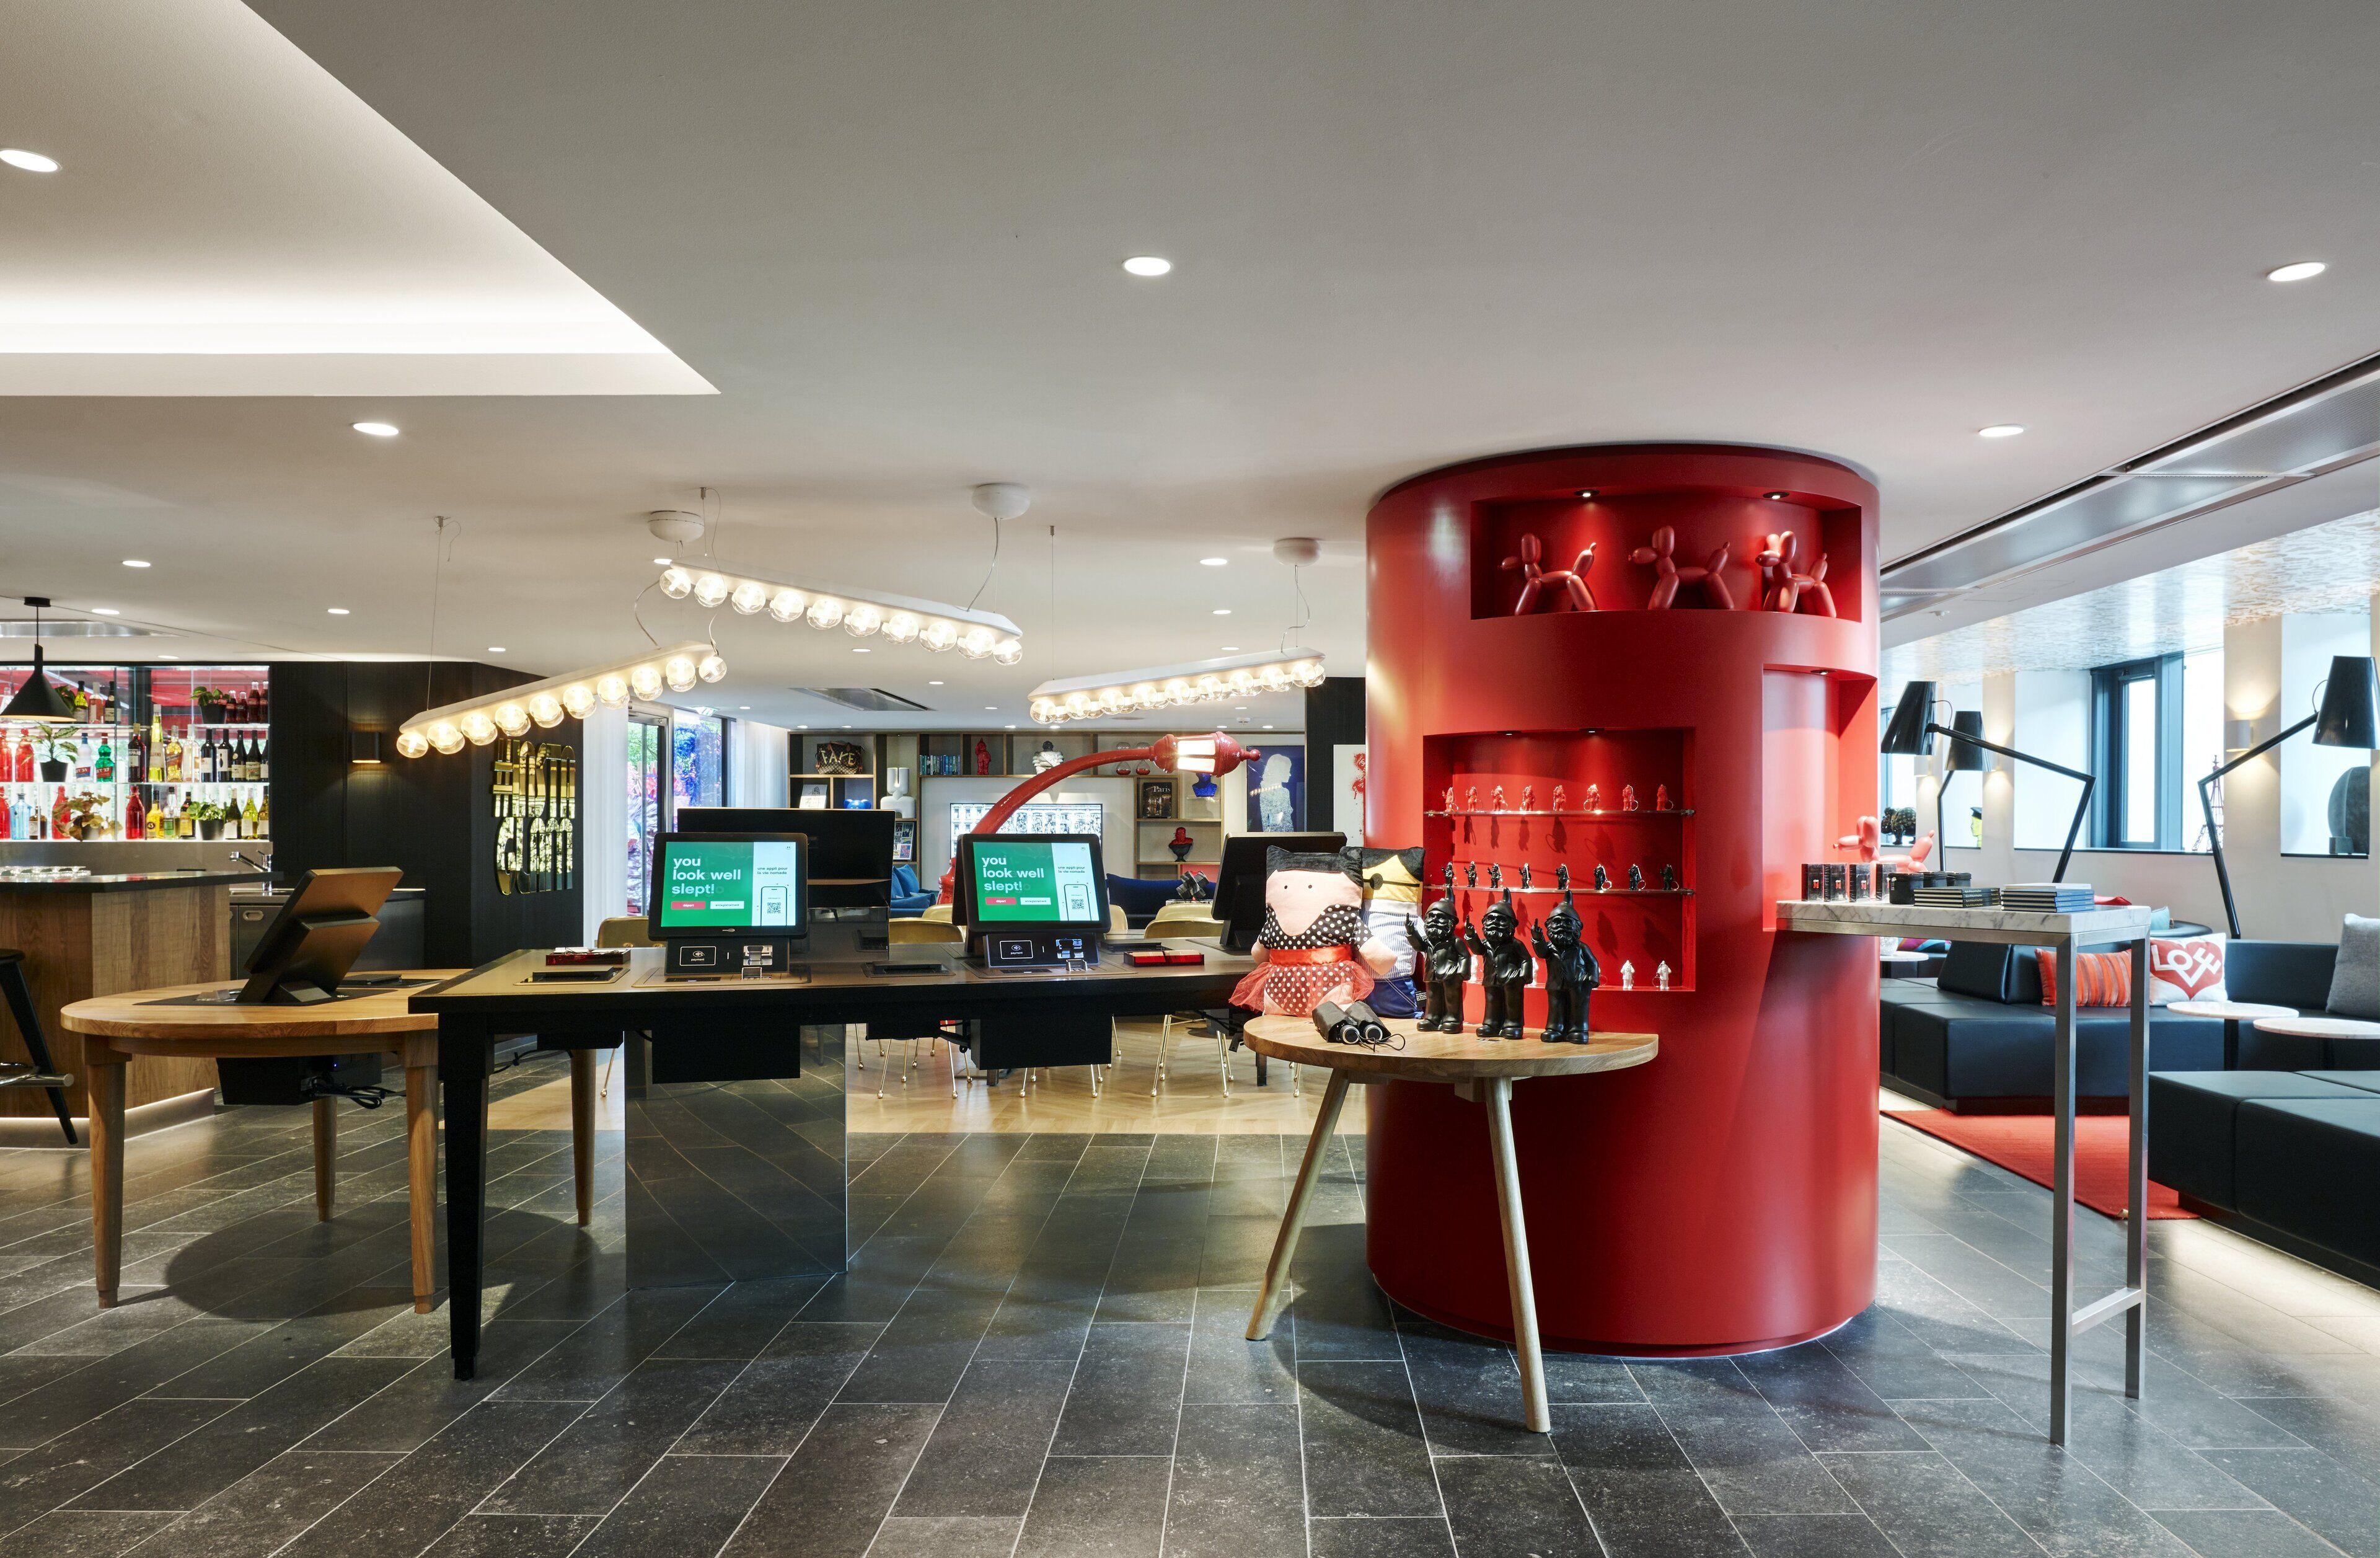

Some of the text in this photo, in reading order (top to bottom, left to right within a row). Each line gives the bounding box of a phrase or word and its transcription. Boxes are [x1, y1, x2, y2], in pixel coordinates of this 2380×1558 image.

[821, 750, 856, 765] FAKE
[673, 858, 700, 869] you
[982, 857, 1007, 867] you
[672, 869, 741, 880] look well
[983, 868, 1044, 878] look well
[672, 883, 715, 897] slept!
[984, 881, 1023, 894] slept!
[2151, 944, 2222, 988] LOVE
